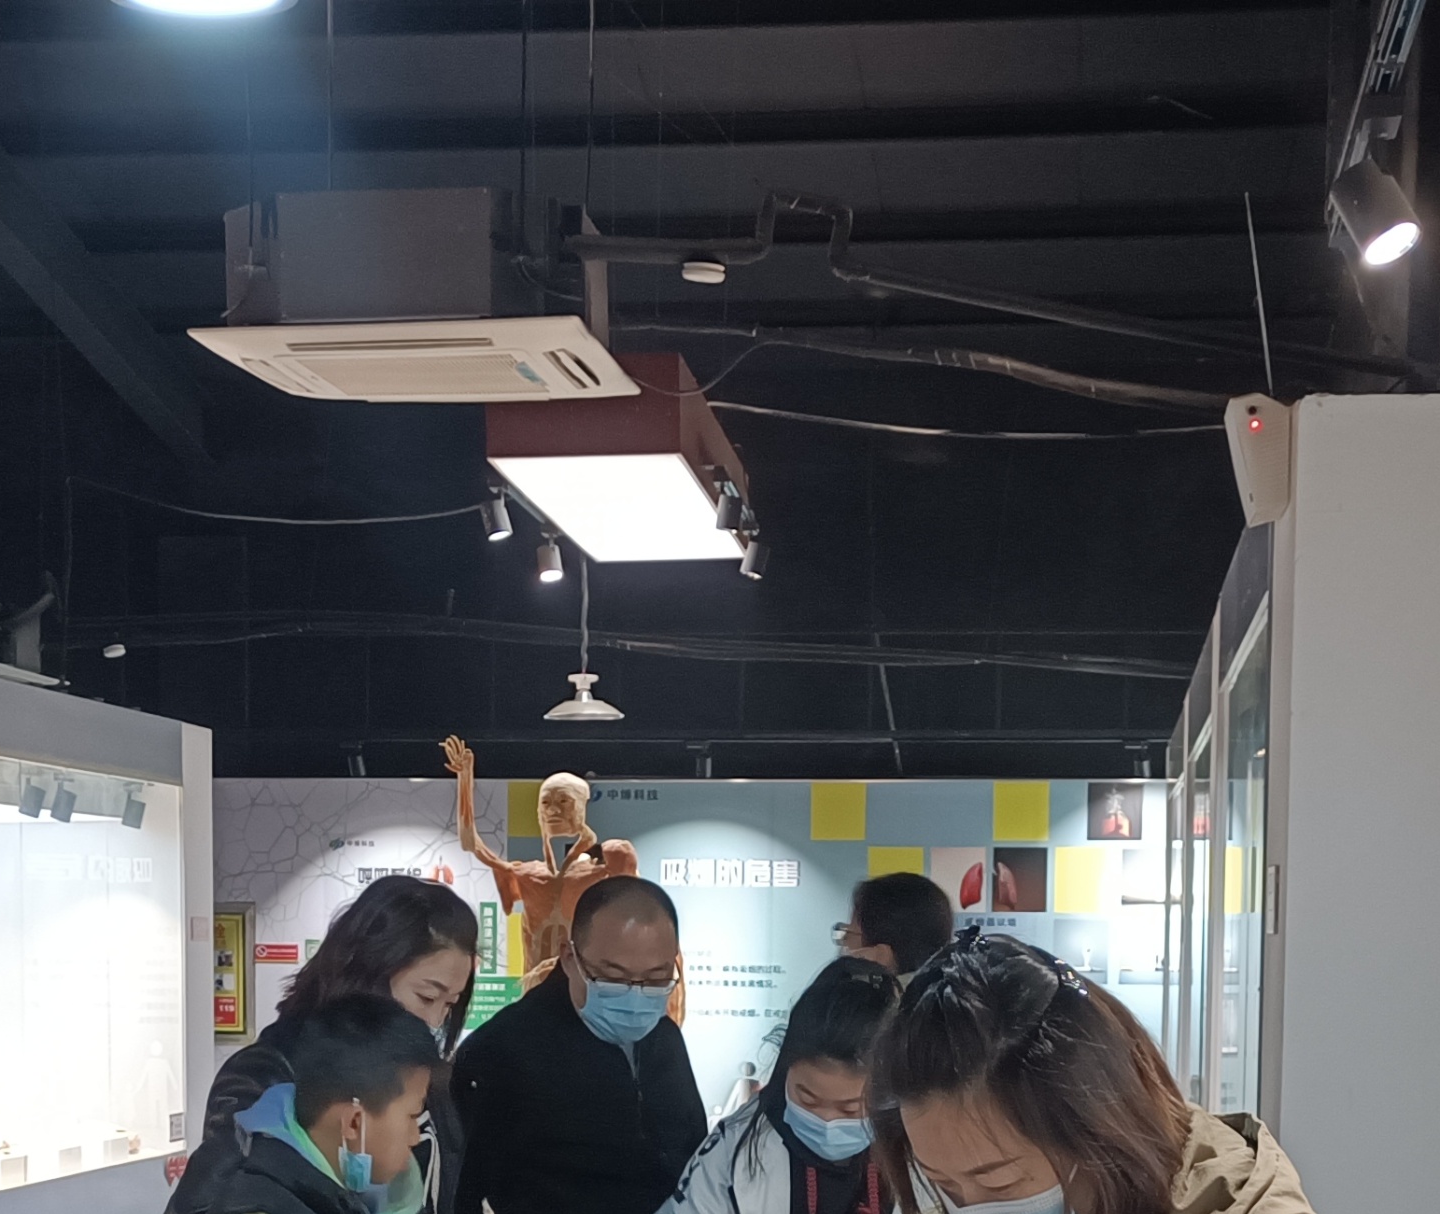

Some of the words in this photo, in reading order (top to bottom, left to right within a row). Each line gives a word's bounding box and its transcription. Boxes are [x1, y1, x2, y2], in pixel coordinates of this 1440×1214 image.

[661, 857, 801, 888] 吸烟的危害
